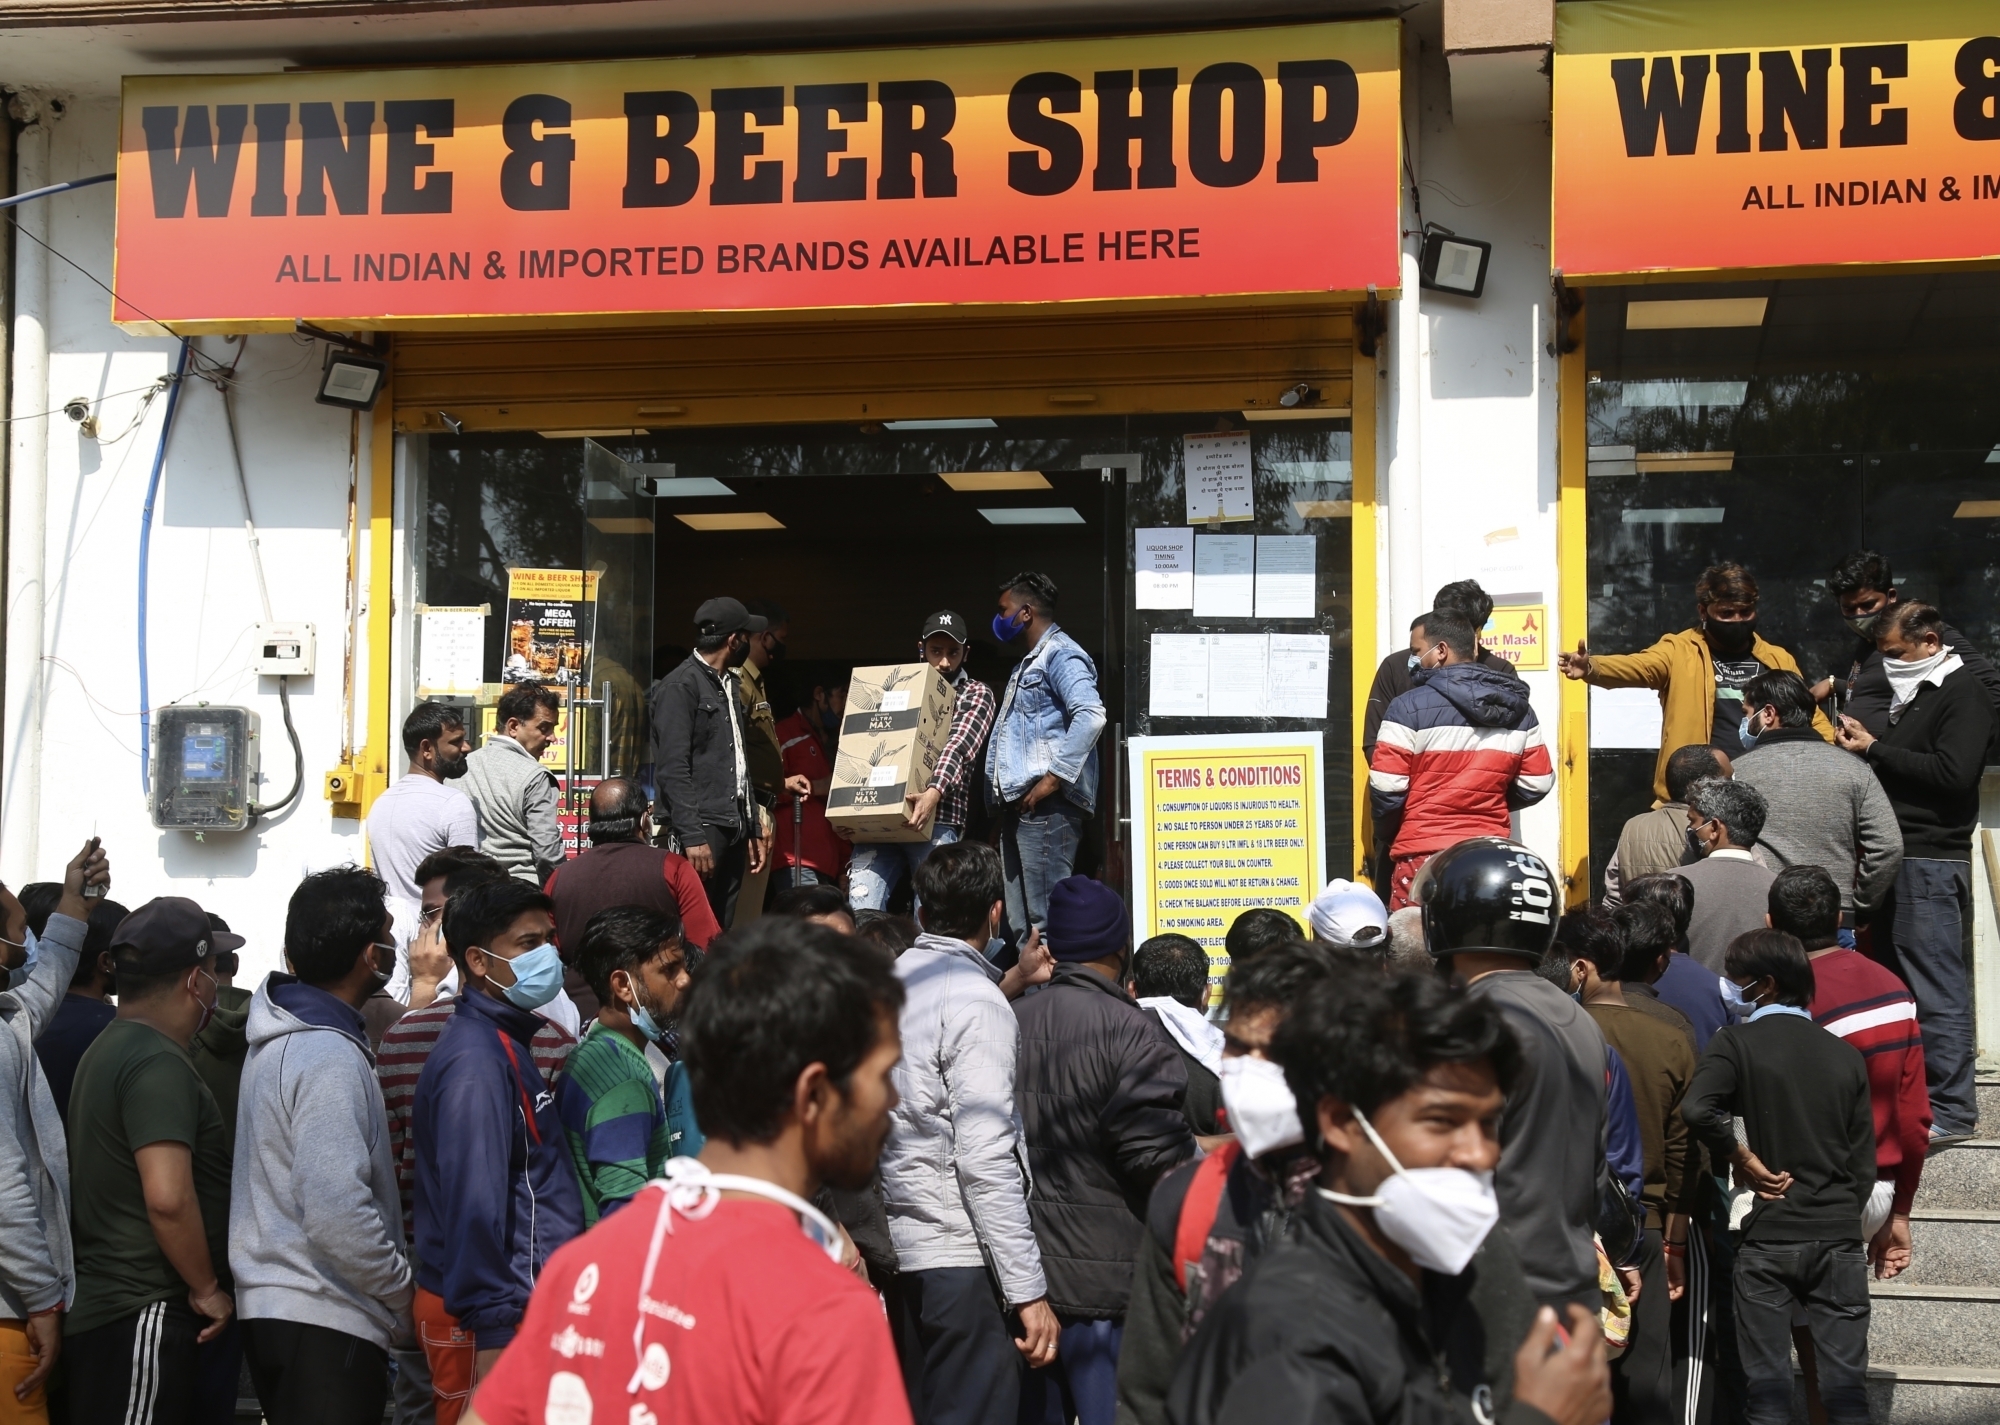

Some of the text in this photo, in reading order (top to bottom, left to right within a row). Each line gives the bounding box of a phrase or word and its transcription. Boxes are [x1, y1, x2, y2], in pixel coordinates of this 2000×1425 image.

[1611, 43, 1908, 158] WINE
[142, 59, 1359, 219] WINE & BEER SHOP
[1742, 185, 1804, 210] ALL
[1815, 178, 1926, 207] INDIAN
[1938, 176, 1961, 201] &
[275, 227, 1200, 283] ALL INDIAN & IMPORTED BRANDS AVAILABLE HERE
[545, 609, 572, 618] MEGA
[539, 618, 576, 627] OFFER!!
[1503, 634, 1536, 645] Mask
[869, 721, 892, 729] MAX
[1157, 766, 1300, 788] TERMS & CONDITIONS
[854, 796, 877, 804] MAX
[1157, 800, 1300, 812] 1. CONSUMPTION OF LIQUORS IS INJURIOUS TO HEALTH.
[1158, 820, 1297, 831] 2. NO SALE TO PERSON UNDER 25 YEARS OF AGE.
[1158, 842, 1162, 850] 3.
[1164, 842, 1174, 850] ONE
[1176, 842, 1196, 850] PERSON
[1198, 841, 1208, 849] CAN
[1210, 841, 1220, 849] BUY
[1227, 841, 1236, 849] LTR
[1257, 840, 1262, 848] 18
[1264, 840, 1273, 848] LTR
[1275, 840, 1288, 848] BEER
[1290, 839, 1304, 847] ONLY.
[1158, 859, 1272, 869] 4. PLEASE COLLECT YOUR BILL ON COUNTER.
[1159, 881, 1163, 889] 5.
[1165, 880, 1182, 888] GOODS
[1184, 880, 1198, 888] ONCE
[1200, 880, 1213, 888] SOLD
[1215, 879, 1226, 887] WILL
[1228, 879, 1238, 887] NOT
[1240, 879, 1246, 887] BE
[1248, 878, 1269, 887] RETURN
[1276, 878, 1299, 886] CHANGE.
[1508, 846, 1552, 925] 1901
[1160, 897, 1300, 908] 6. CHECK THE BALANCE BEFORE LEAVING OF COUNTER.
[1160, 918, 1224, 927] 7. NO SMOKING AREA.
